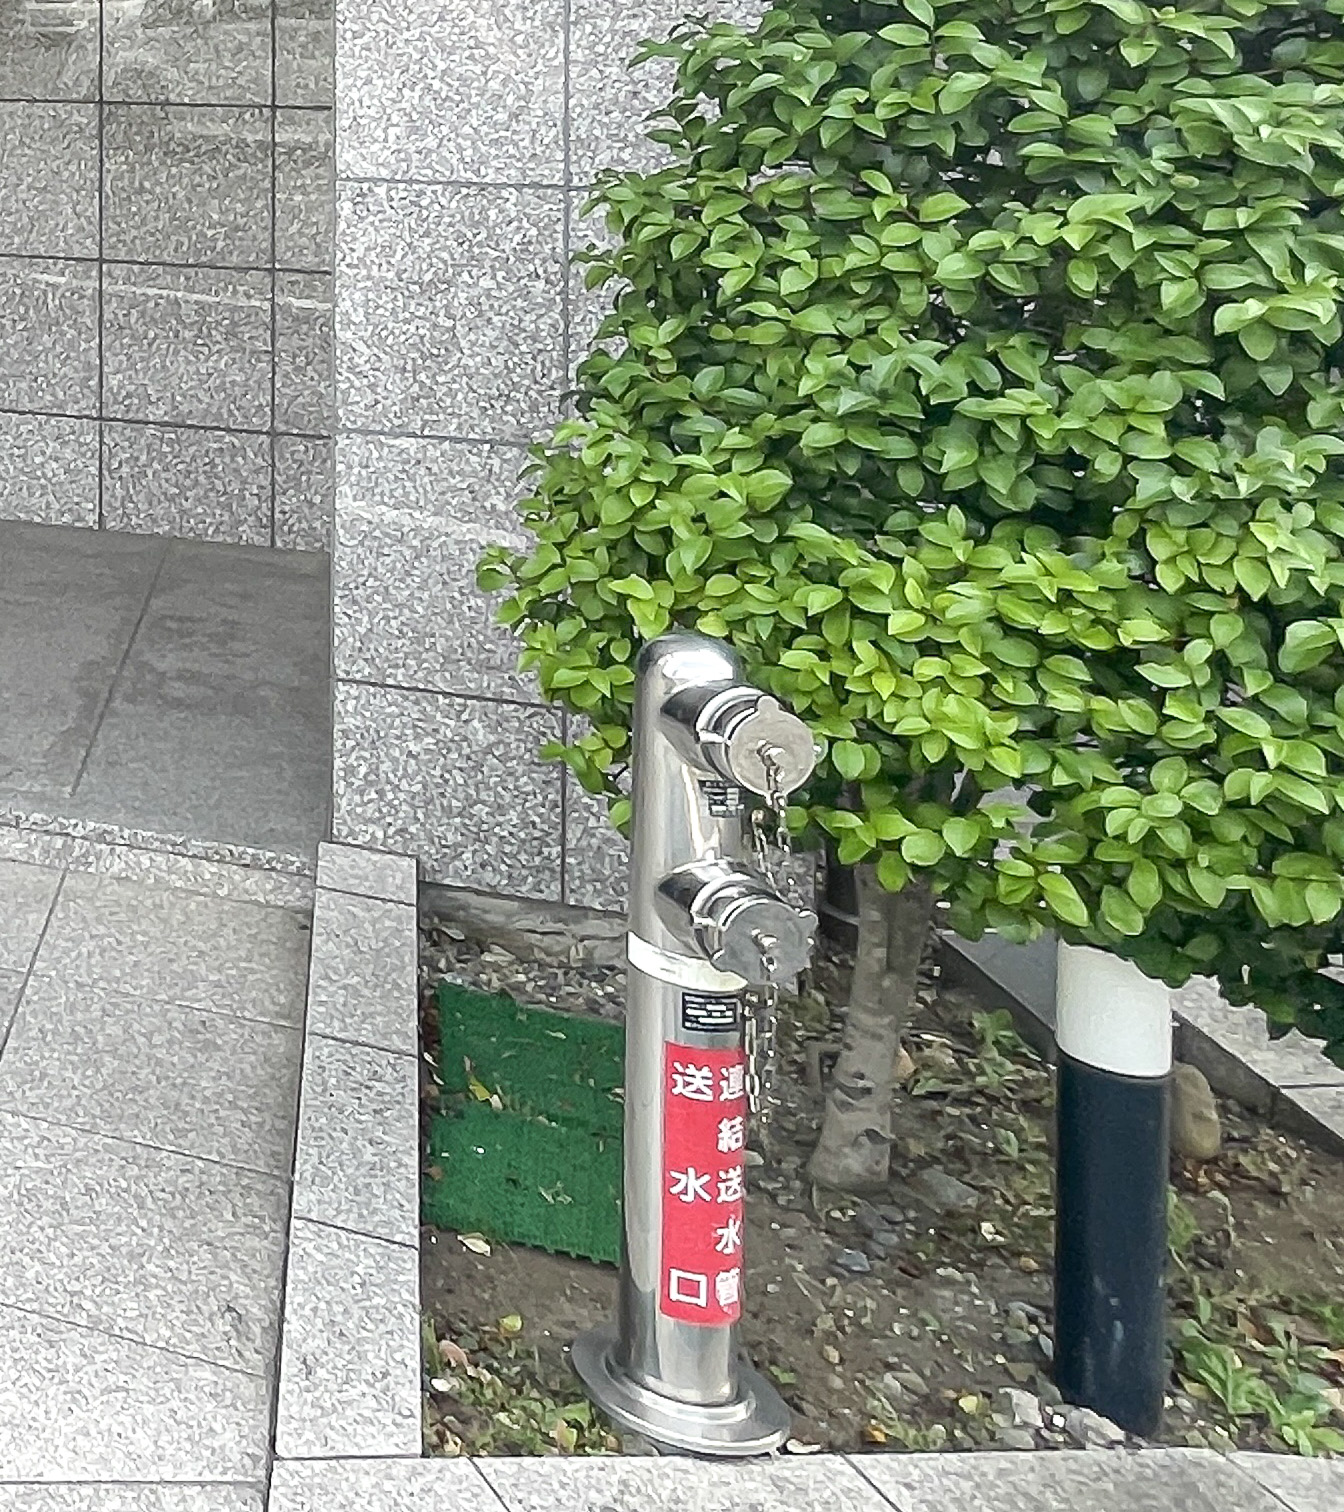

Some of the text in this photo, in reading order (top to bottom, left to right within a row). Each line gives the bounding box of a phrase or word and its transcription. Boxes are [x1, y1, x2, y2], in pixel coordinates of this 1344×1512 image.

[668, 1061, 714, 1308] 送水口
[714, 1063, 744, 1308] 連結送水管
